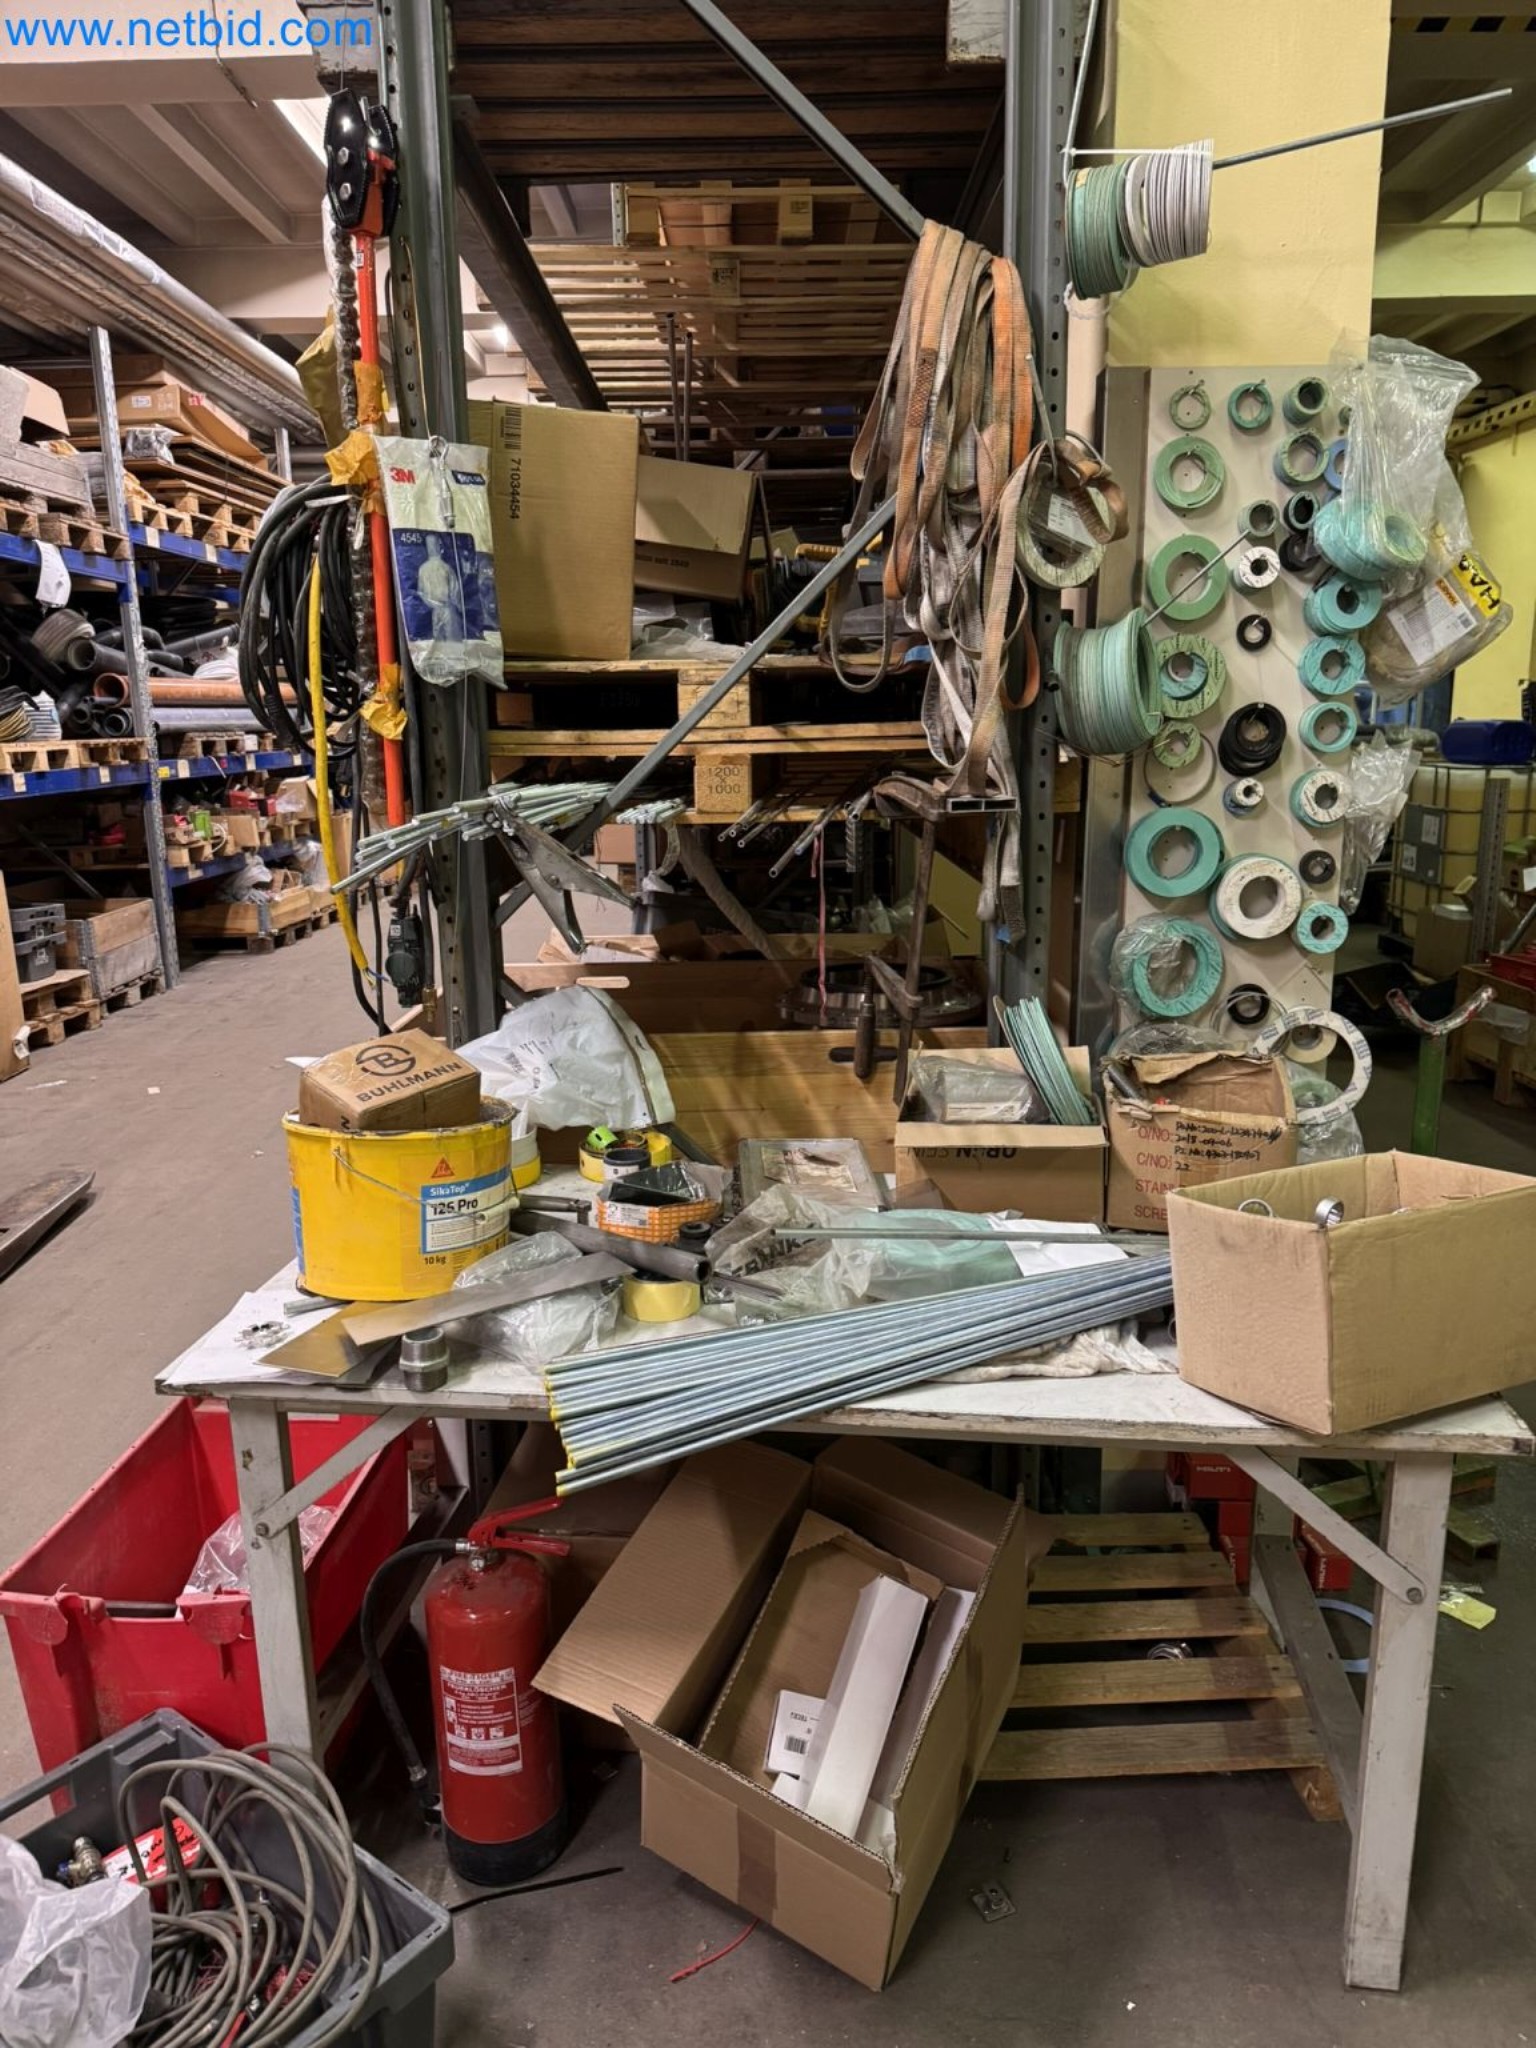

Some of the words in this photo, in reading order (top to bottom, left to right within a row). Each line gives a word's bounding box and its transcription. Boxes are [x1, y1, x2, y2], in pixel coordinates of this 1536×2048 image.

[390, 466, 416, 484] 3M
[510, 458, 522, 520] 71034454
[708, 766, 740, 777] 1200
[708, 783, 740, 794] 1000
[356, 1062, 462, 1102] BUHLMANN
[457, 1198, 479, 1212] Pro
[425, 1256, 434, 1265] 10
[436, 1255, 446, 1266] kg
